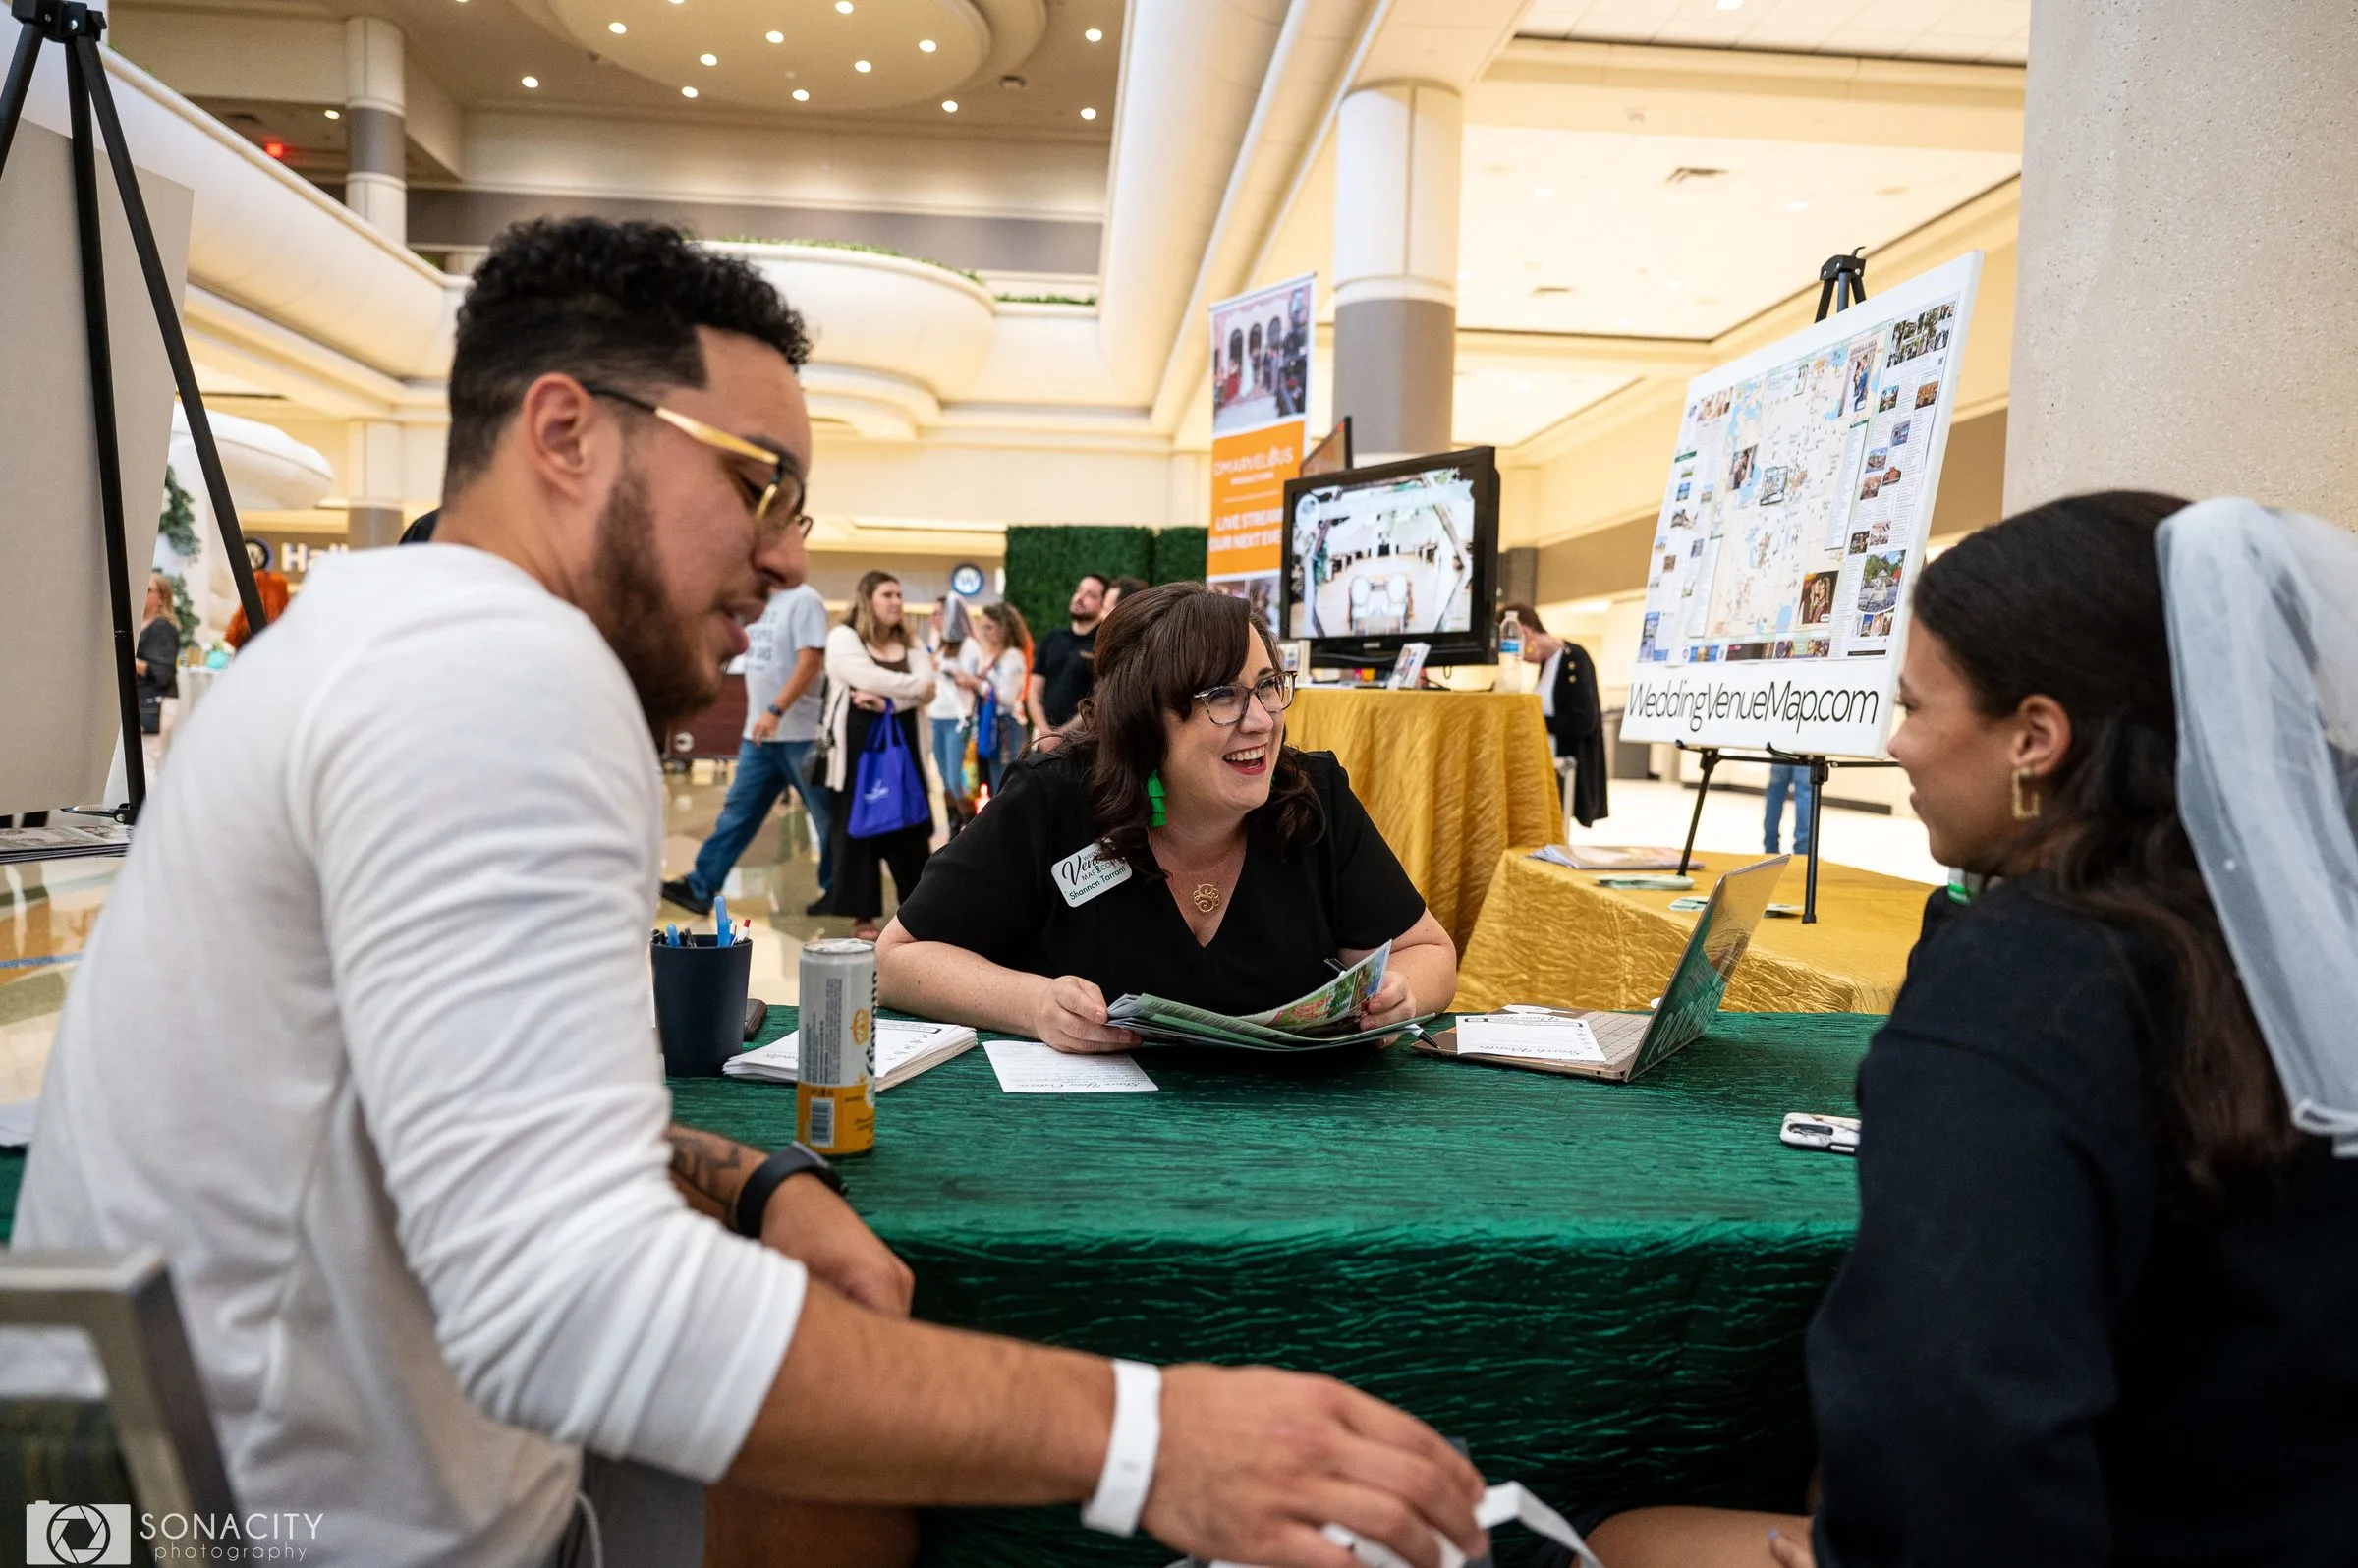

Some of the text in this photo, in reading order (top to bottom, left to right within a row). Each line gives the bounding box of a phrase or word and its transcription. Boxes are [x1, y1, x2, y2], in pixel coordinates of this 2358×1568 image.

[1629, 680, 1879, 734] WeddingVenueMap.com
[1069, 866, 1127, 900] Shannon Tarrant
